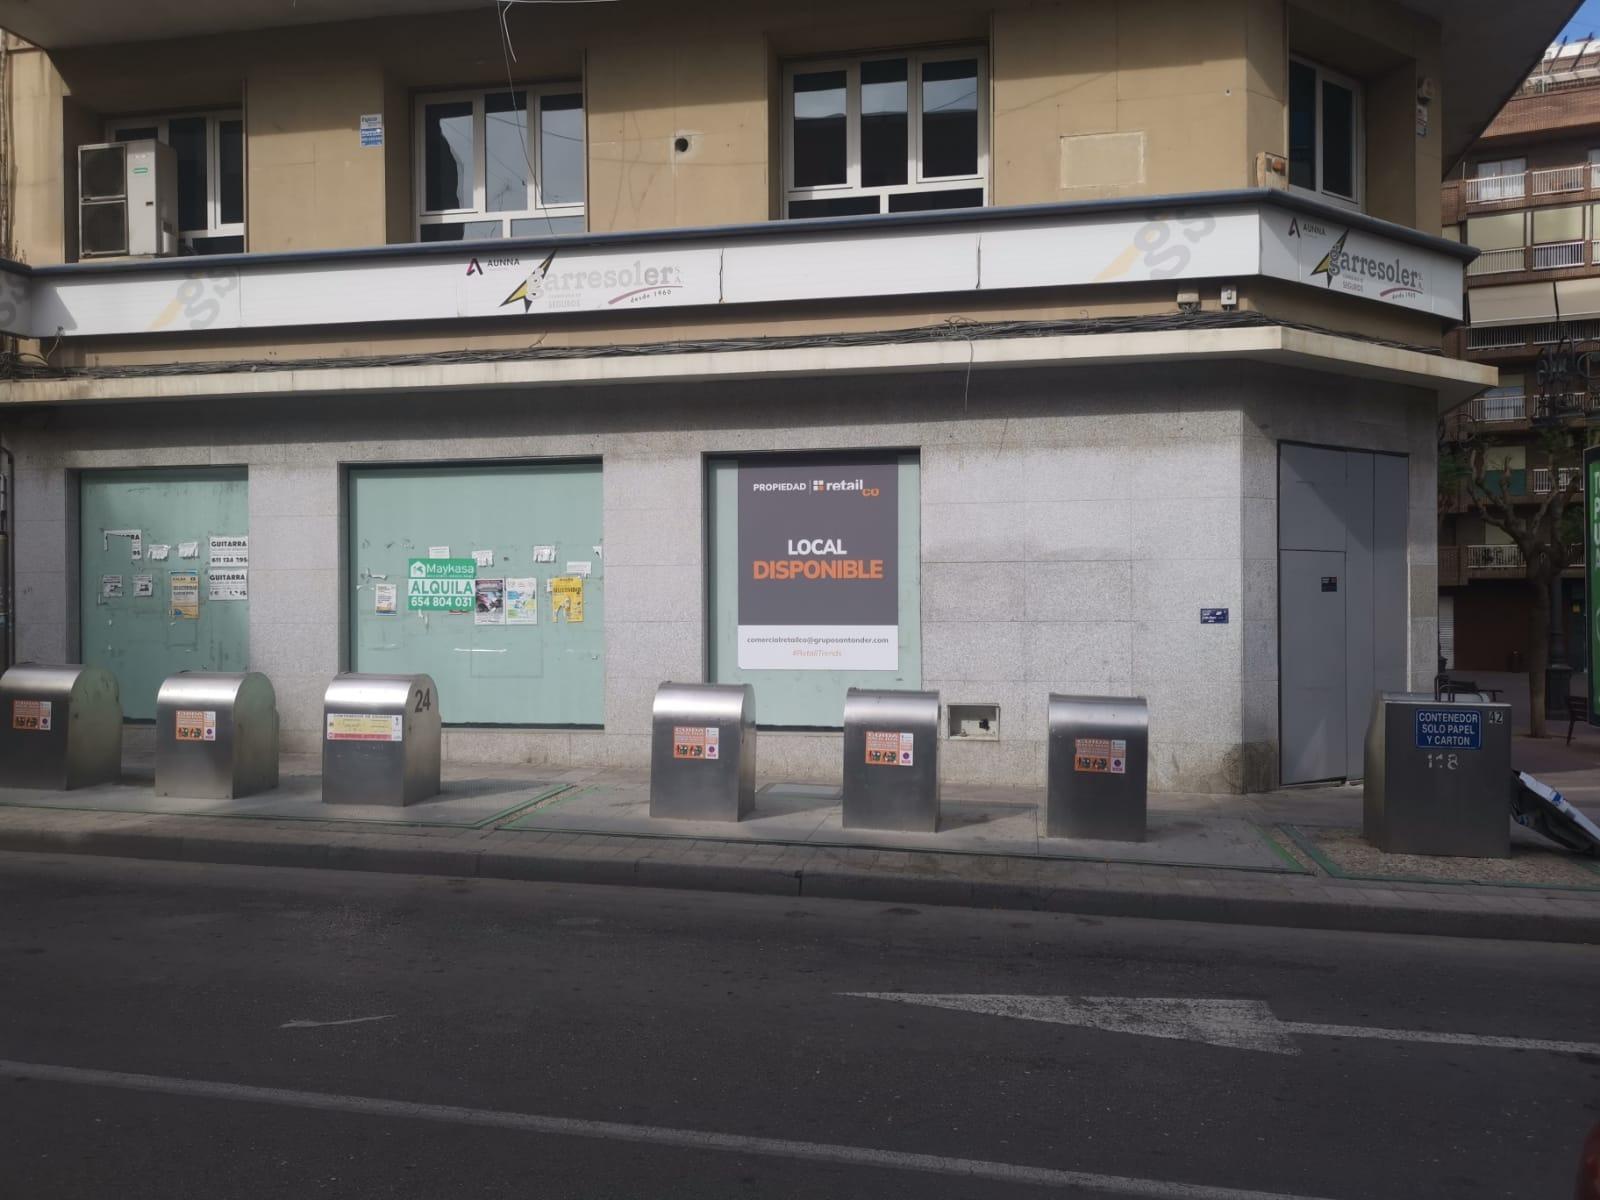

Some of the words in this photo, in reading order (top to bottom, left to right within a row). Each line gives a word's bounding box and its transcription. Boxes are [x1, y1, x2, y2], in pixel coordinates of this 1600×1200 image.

[487, 257, 520, 267] AUNNA
[753, 482, 807, 492] PROPIEDAD
[787, 539, 848, 556] LOCAL
[427, 563, 474, 576] Maykasa
[753, 559, 884, 580] DISPONIBLE
[209, 573, 246, 581] GUITARRA
[410, 580, 473, 595] ALQUILA
[411, 597, 430, 607] 654
[432, 597, 452, 607] 804
[455, 597, 472, 607] 031
[414, 687, 432, 713] 24
[1418, 712, 1478, 723] CONTENEDOR
[1422, 724, 1446, 734] SOLO
[1447, 725, 1475, 735] PAPEL
[1427, 735, 1433, 745] Y
[1434, 735, 1471, 746] CARTON
